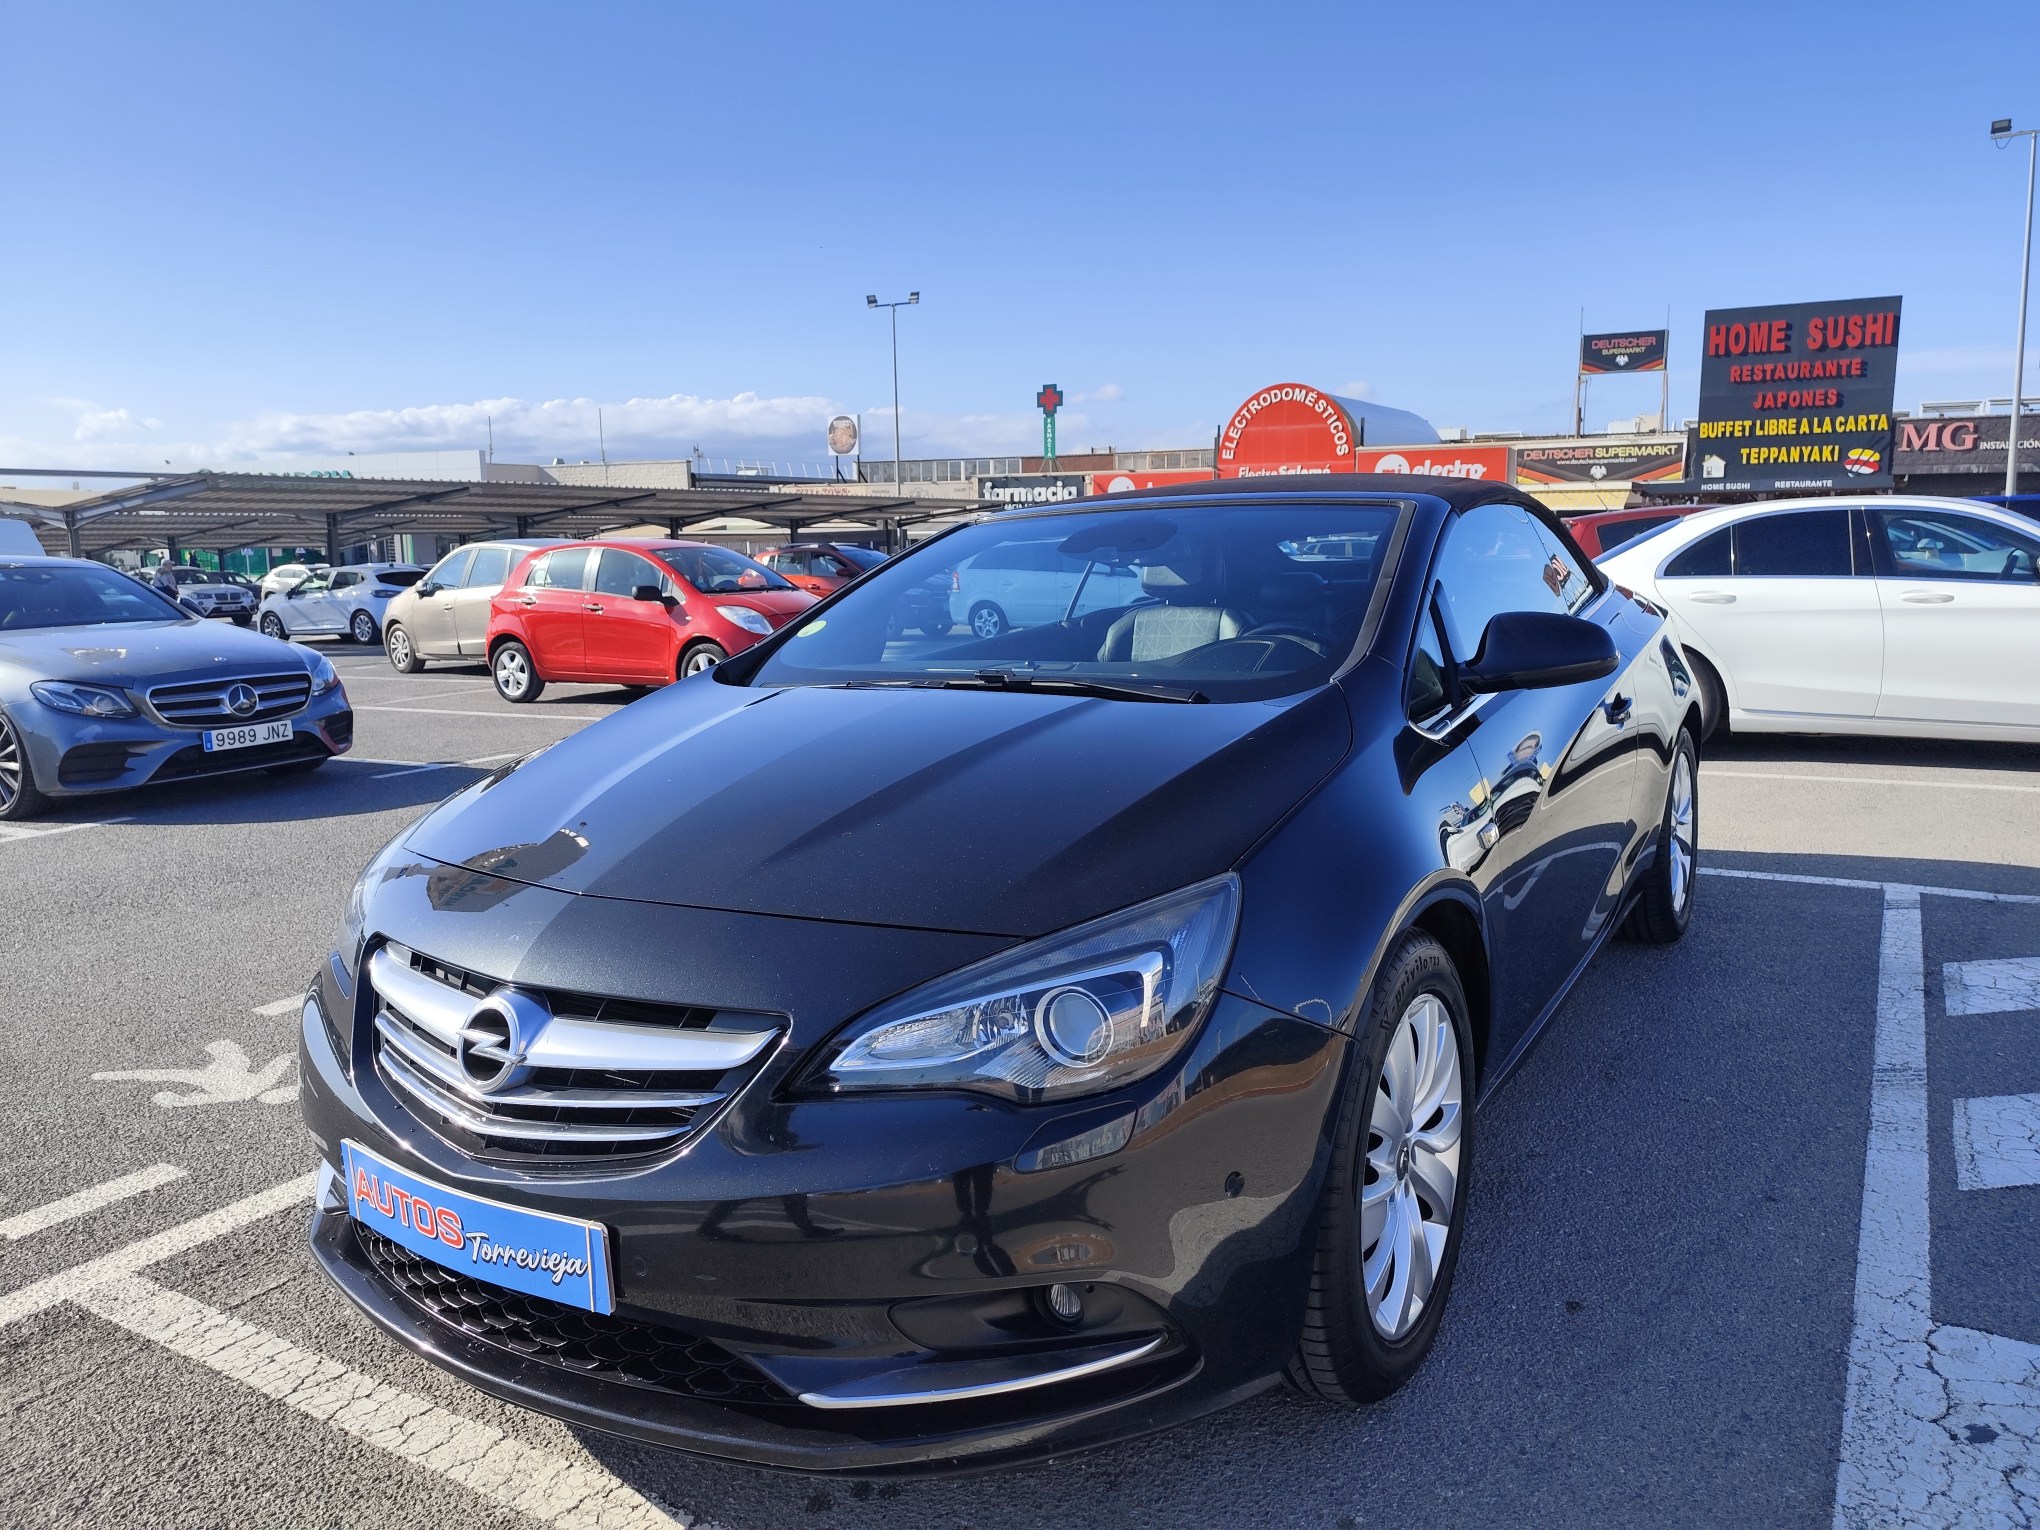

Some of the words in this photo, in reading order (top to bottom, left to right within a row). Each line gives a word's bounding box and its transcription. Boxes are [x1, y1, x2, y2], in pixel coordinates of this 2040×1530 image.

[1592, 336, 1656, 349] DEUTSCHER
[1708, 320, 1787, 356] HOME
[1807, 312, 1895, 350] SUSHI
[1602, 346, 1646, 355] SUPERMARKT
[1729, 358, 1863, 382] RESTAURANTE
[1753, 389, 1838, 409] JAPONES
[1222, 387, 1349, 460] ELECTRODOMÉSTICOS
[1700, 420, 1752, 438] BUFFET
[1756, 418, 1797, 436] LIBRE
[1800, 418, 1810, 434] A
[1813, 416, 1833, 434] LA
[1835, 414, 1889, 433] CARTA
[1897, 421, 1979, 452] MG
[1524, 448, 1593, 460] DEUTSCHER
[1595, 445, 1678, 457] SUPERMARKT
[1741, 445, 1840, 465] TEPPANYAKI
[983, 481, 1078, 502] farmacia
[1701, 483, 1724, 491] HOME
[1725, 482, 1750, 490] SUSHI
[1775, 480, 1833, 488] RESTAURANTE
[215, 728, 257, 747] 9989
[263, 723, 289, 741] JNZ
[356, 1167, 467, 1250] AUTOS
[465, 1231, 588, 1286] Torrevieja
